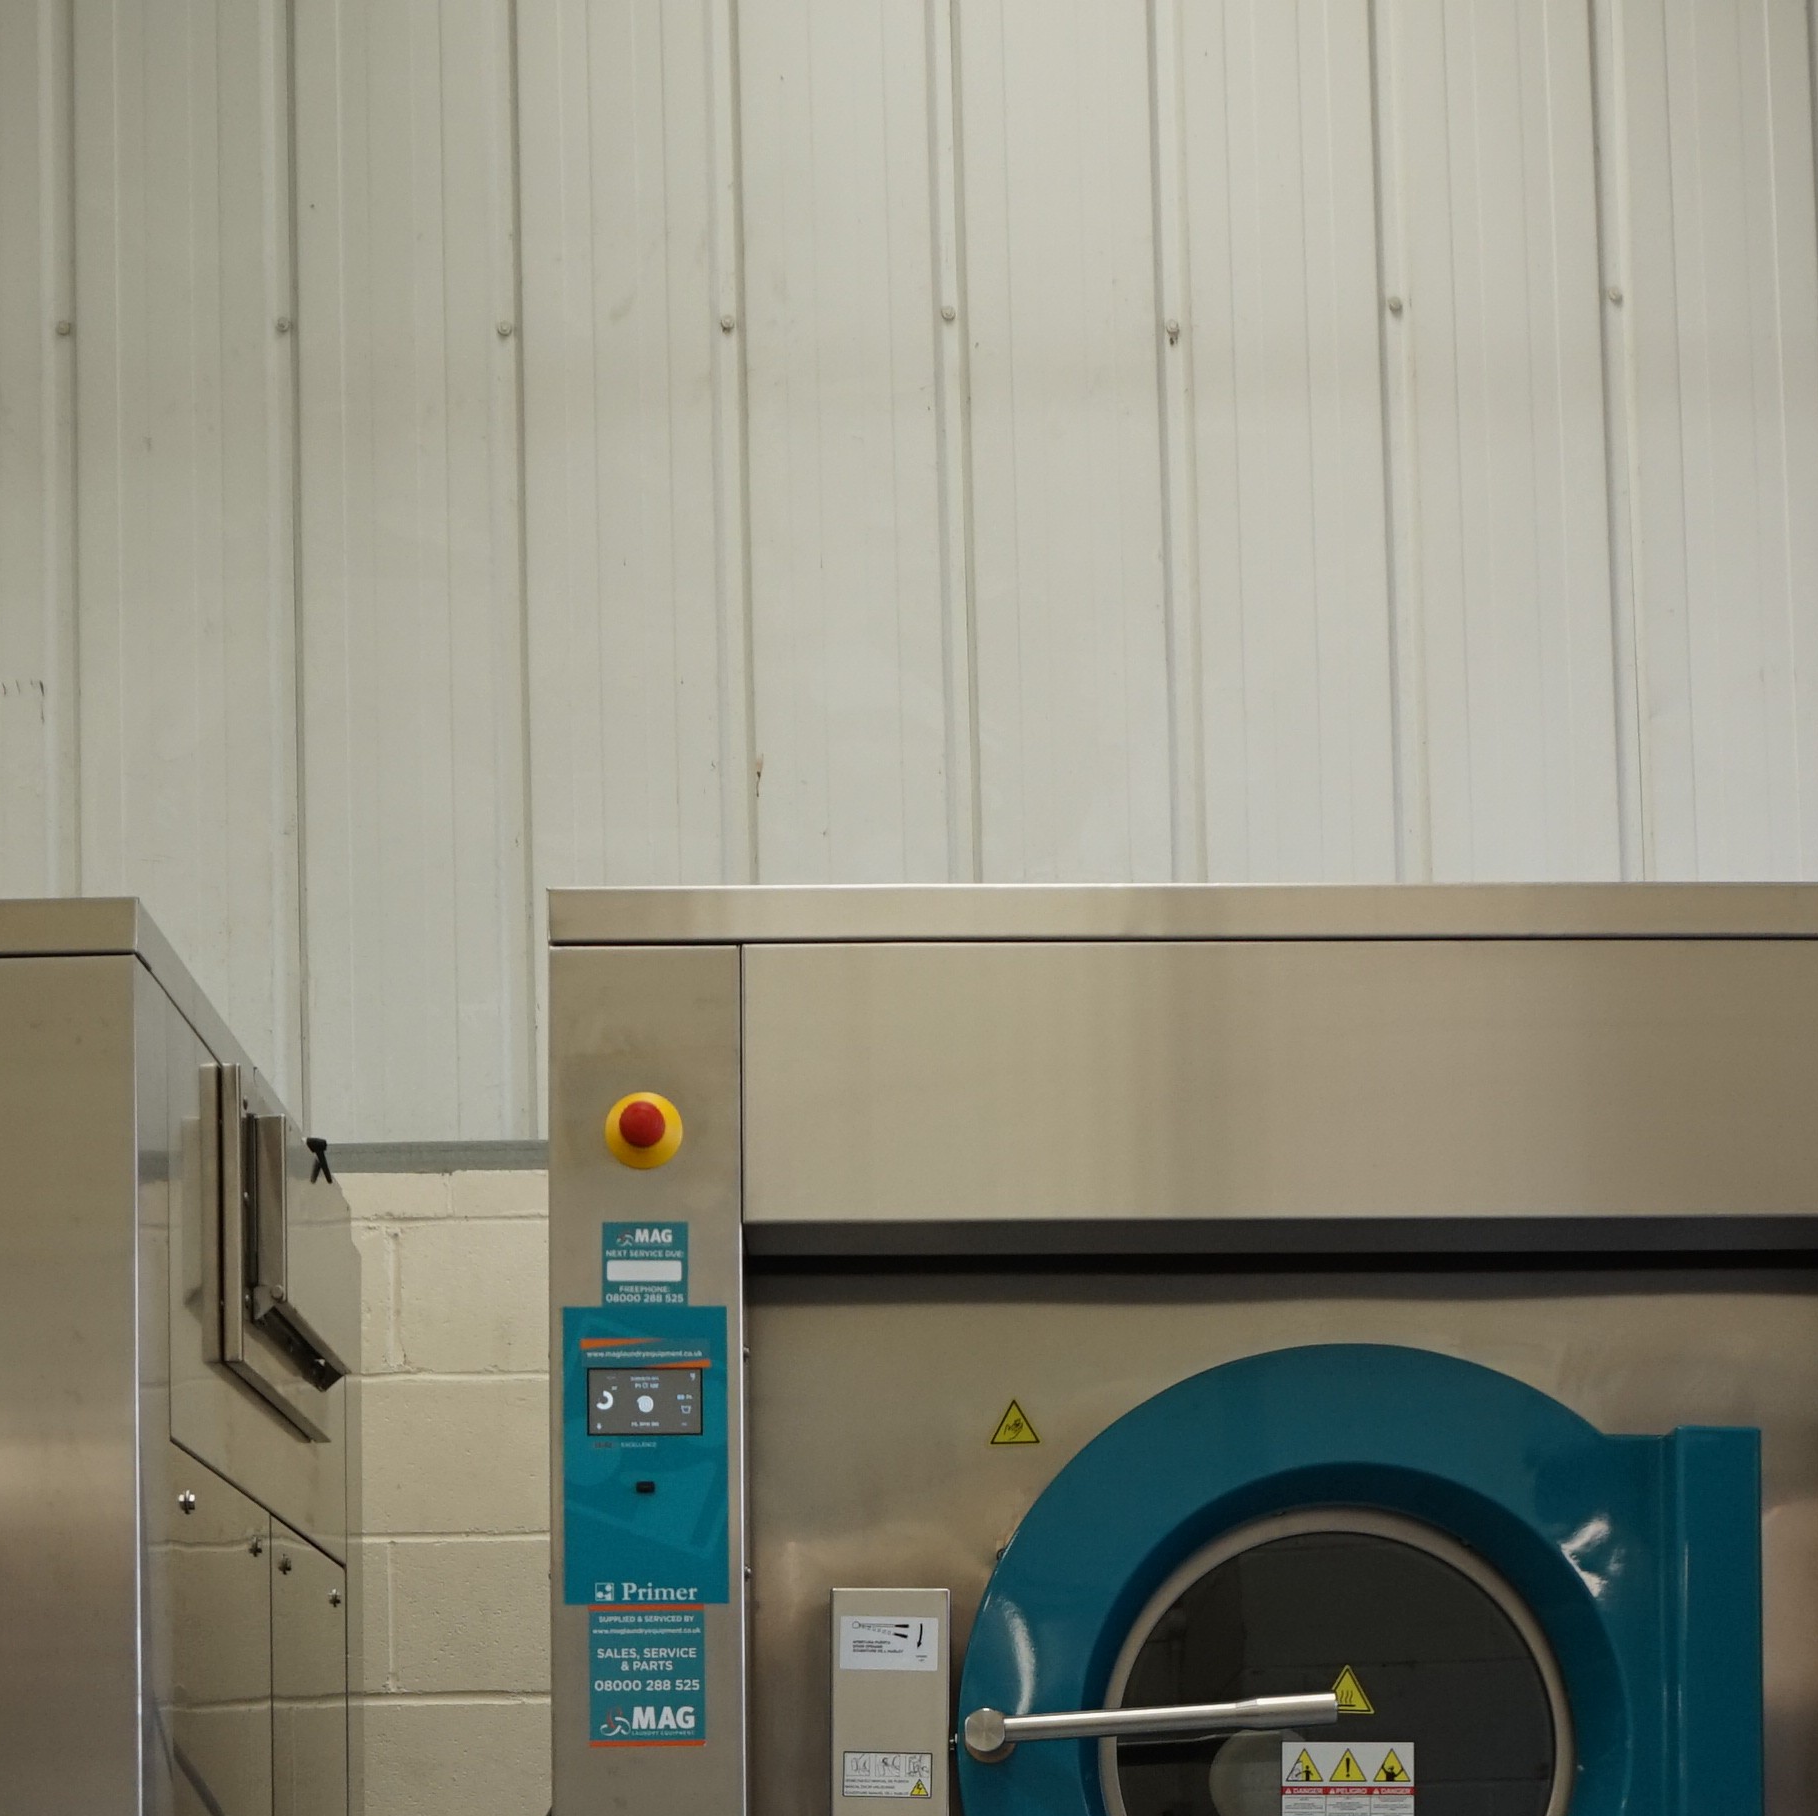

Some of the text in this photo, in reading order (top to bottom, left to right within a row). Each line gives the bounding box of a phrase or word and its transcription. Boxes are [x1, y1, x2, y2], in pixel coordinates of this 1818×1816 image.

[634, 1228, 673, 1243] MAG
[605, 1249, 627, 1258] NEXT
[629, 1249, 662, 1258] SERVICE
[605, 1293, 684, 1303] 08000 288 525
[621, 1582, 698, 1601] Primer
[598, 1615, 635, 1623] SUPPLIED
[644, 1615, 682, 1623] SERVICED
[597, 1647, 697, 1660] SALES, SERVICE
[621, 1660, 673, 1671] & PARTS
[594, 1679, 700, 1691] 08000 288 525
[632, 1706, 695, 1730] MAG
